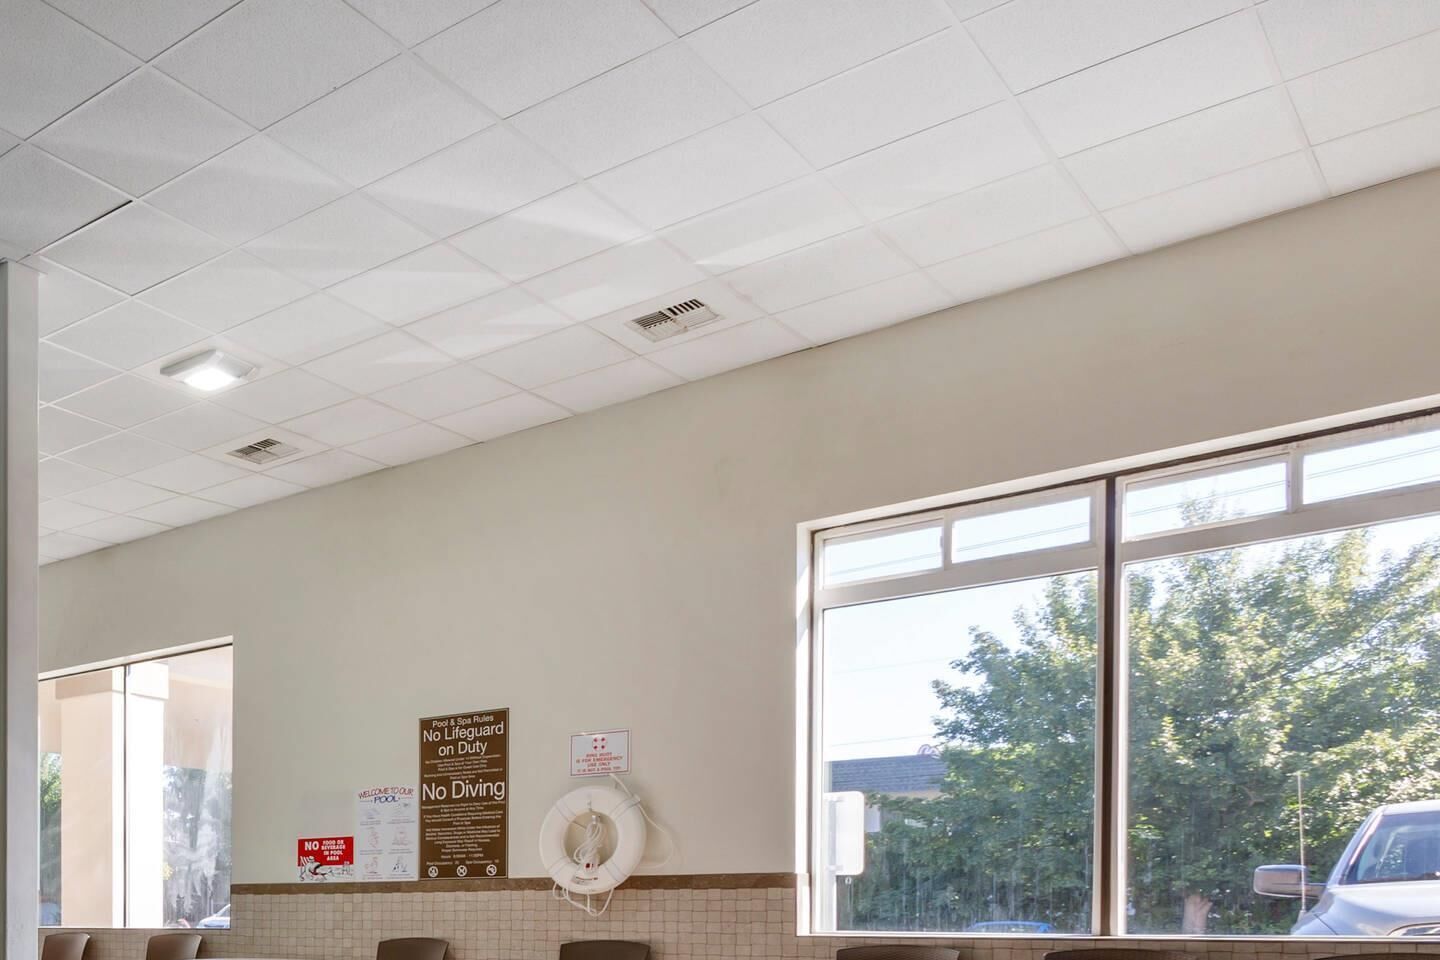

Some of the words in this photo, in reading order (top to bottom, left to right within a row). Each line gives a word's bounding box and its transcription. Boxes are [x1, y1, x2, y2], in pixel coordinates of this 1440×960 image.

[432, 720, 448, 728] Pool
[450, 718, 456, 726] &
[457, 717, 471, 726] Spa
[473, 714, 494, 723] Rules
[423, 729, 441, 742] No
[444, 721, 504, 740] Lifeguard
[438, 745, 454, 756] on
[458, 740, 488, 755] Duty
[358, 787, 390, 799] WELCOME
[399, 787, 414, 796] OUR
[422, 782, 447, 800] No
[452, 779, 505, 800] Diving
[373, 795, 399, 804] POOL
[304, 841, 319, 851] NO
